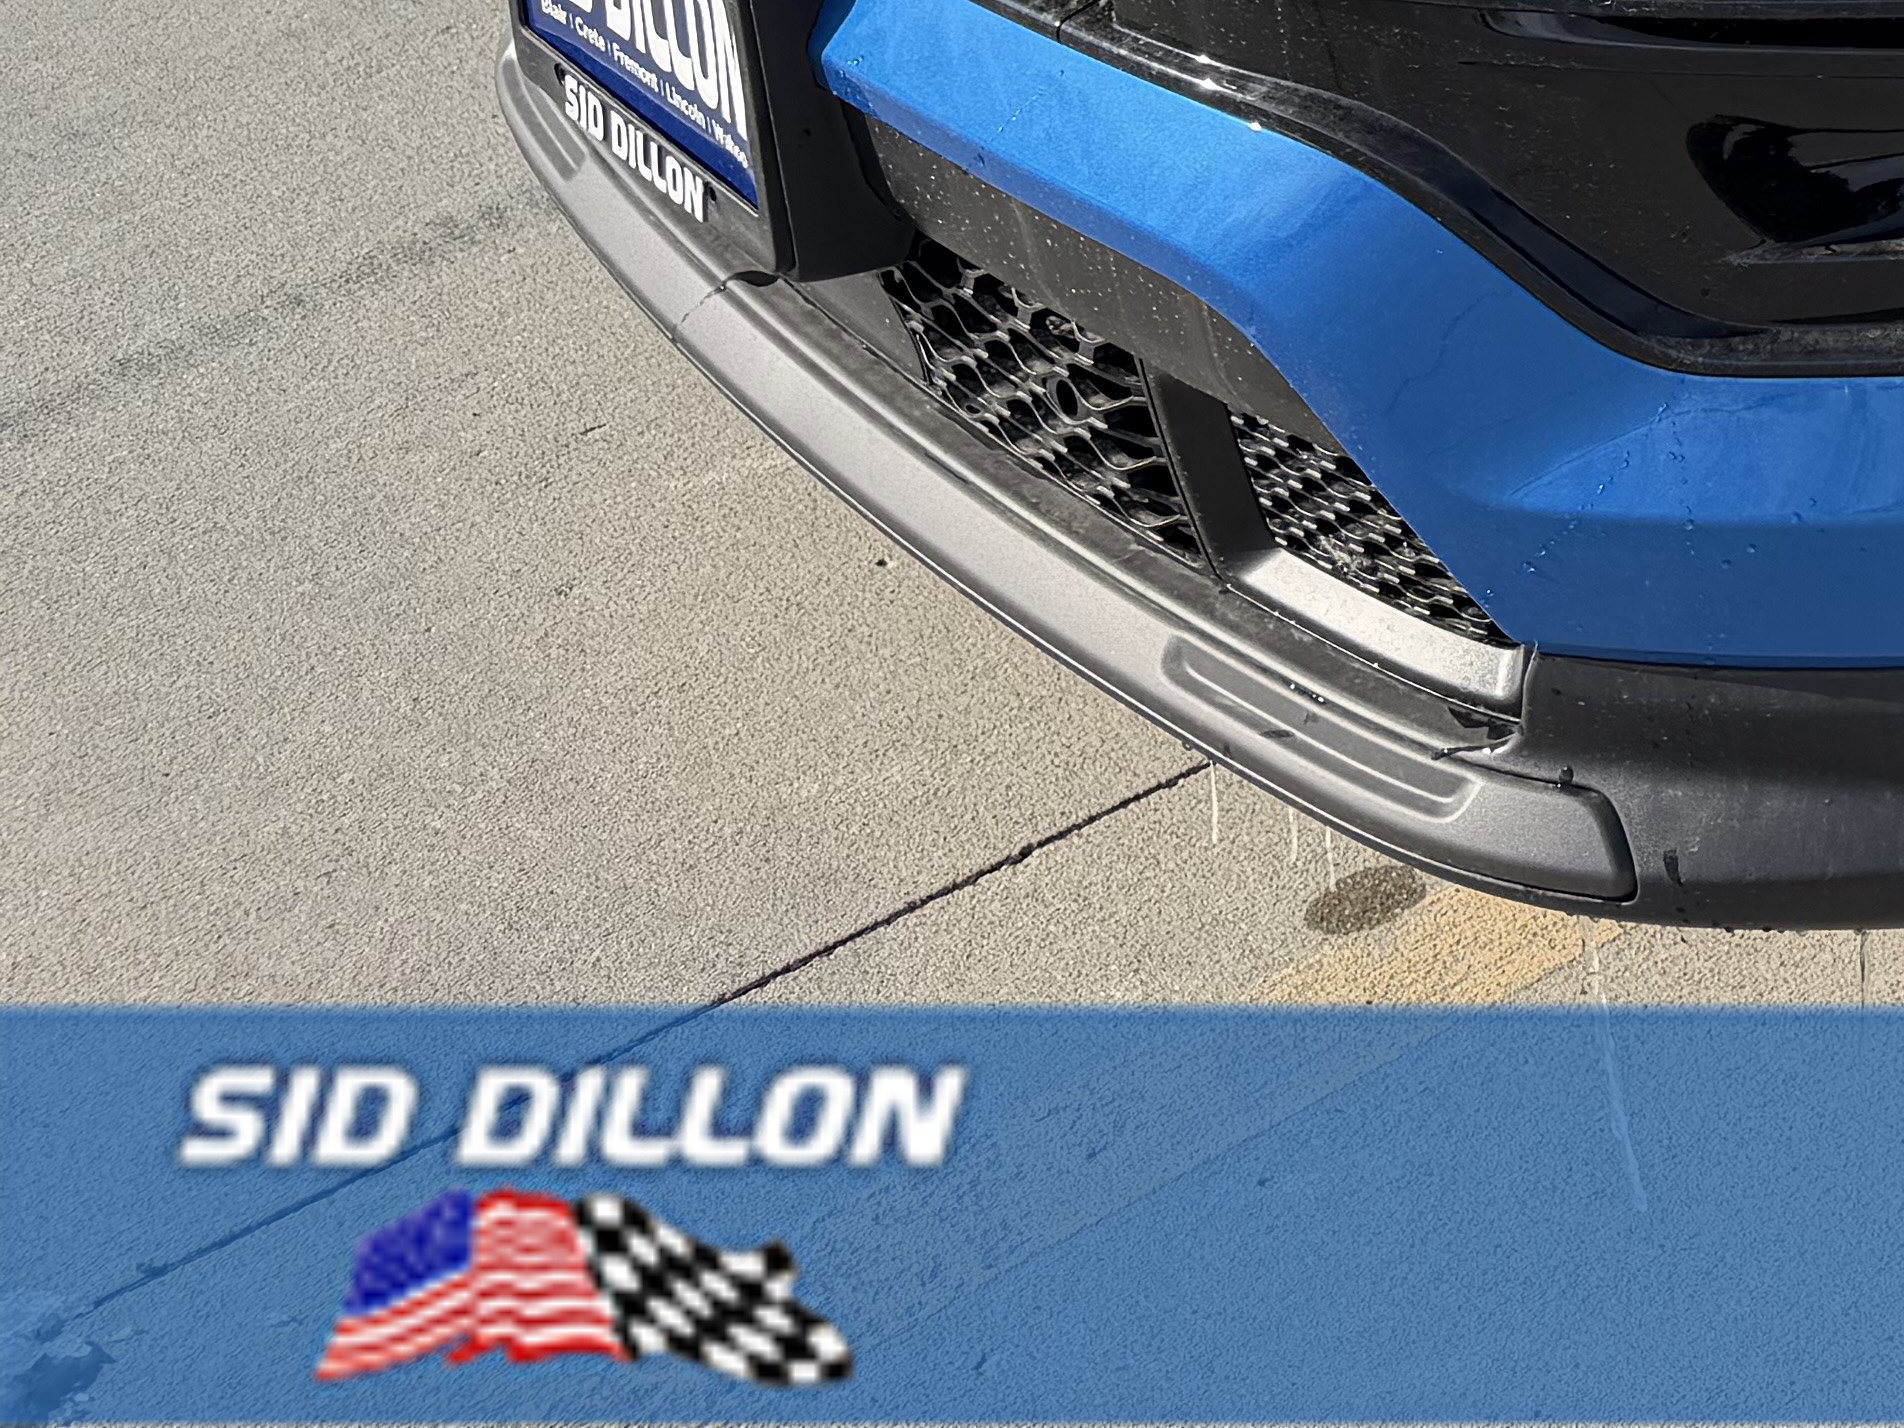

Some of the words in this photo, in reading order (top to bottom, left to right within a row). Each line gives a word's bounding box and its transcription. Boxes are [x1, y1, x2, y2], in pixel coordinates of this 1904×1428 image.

[575, 15, 606, 53] Crete
[614, 41, 659, 93] Fremont
[666, 81, 706, 130] Lincoln
[563, 73, 605, 142] SID
[610, 109, 704, 224] DILLON
